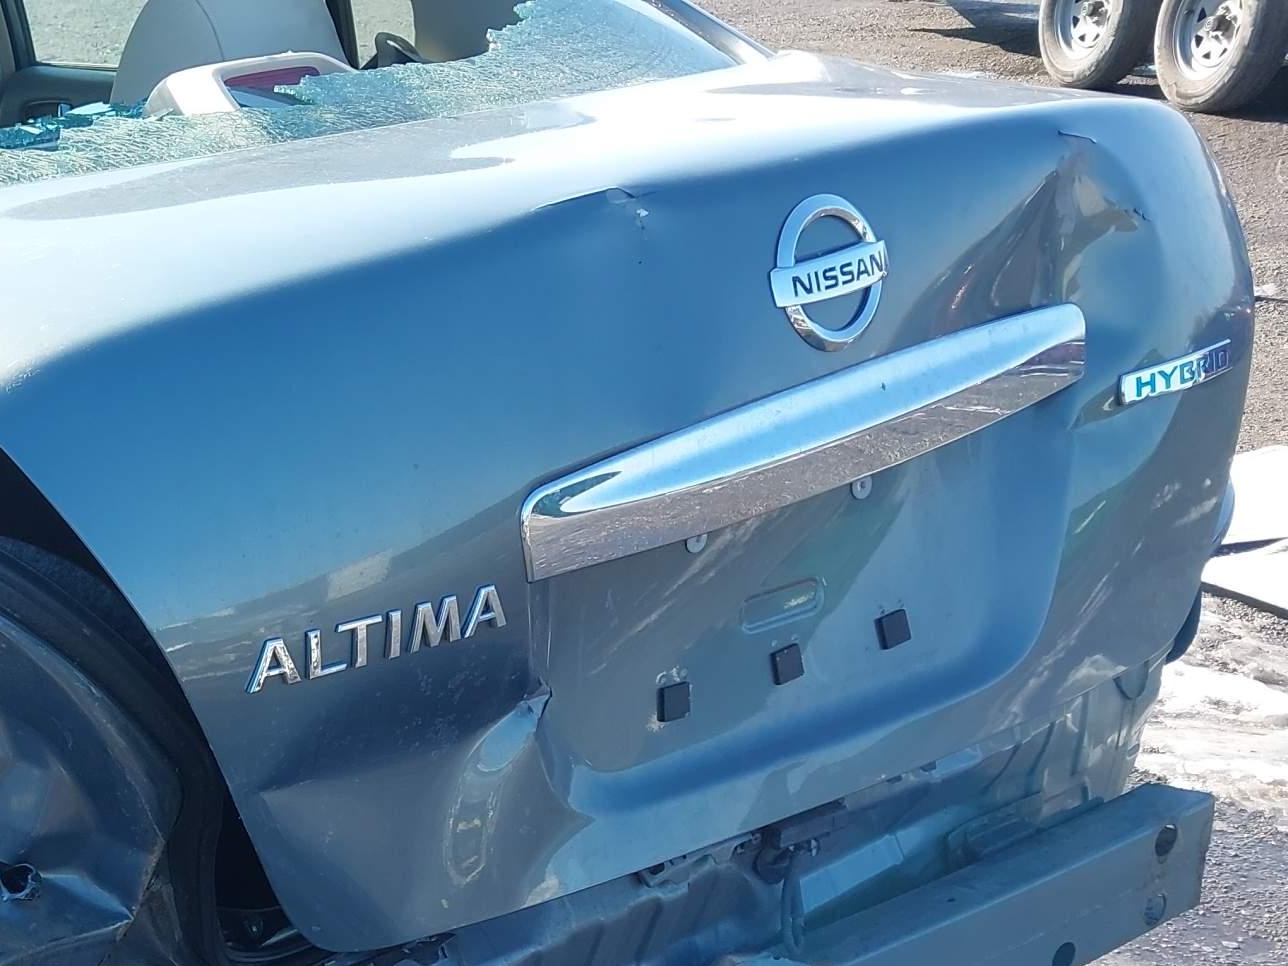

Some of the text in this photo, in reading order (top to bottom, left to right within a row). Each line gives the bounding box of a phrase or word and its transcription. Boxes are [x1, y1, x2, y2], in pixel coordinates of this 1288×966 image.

[791, 250, 887, 298] NISSAN
[1135, 350, 1230, 398] HYBRID
[245, 584, 507, 694] ALTIMA
